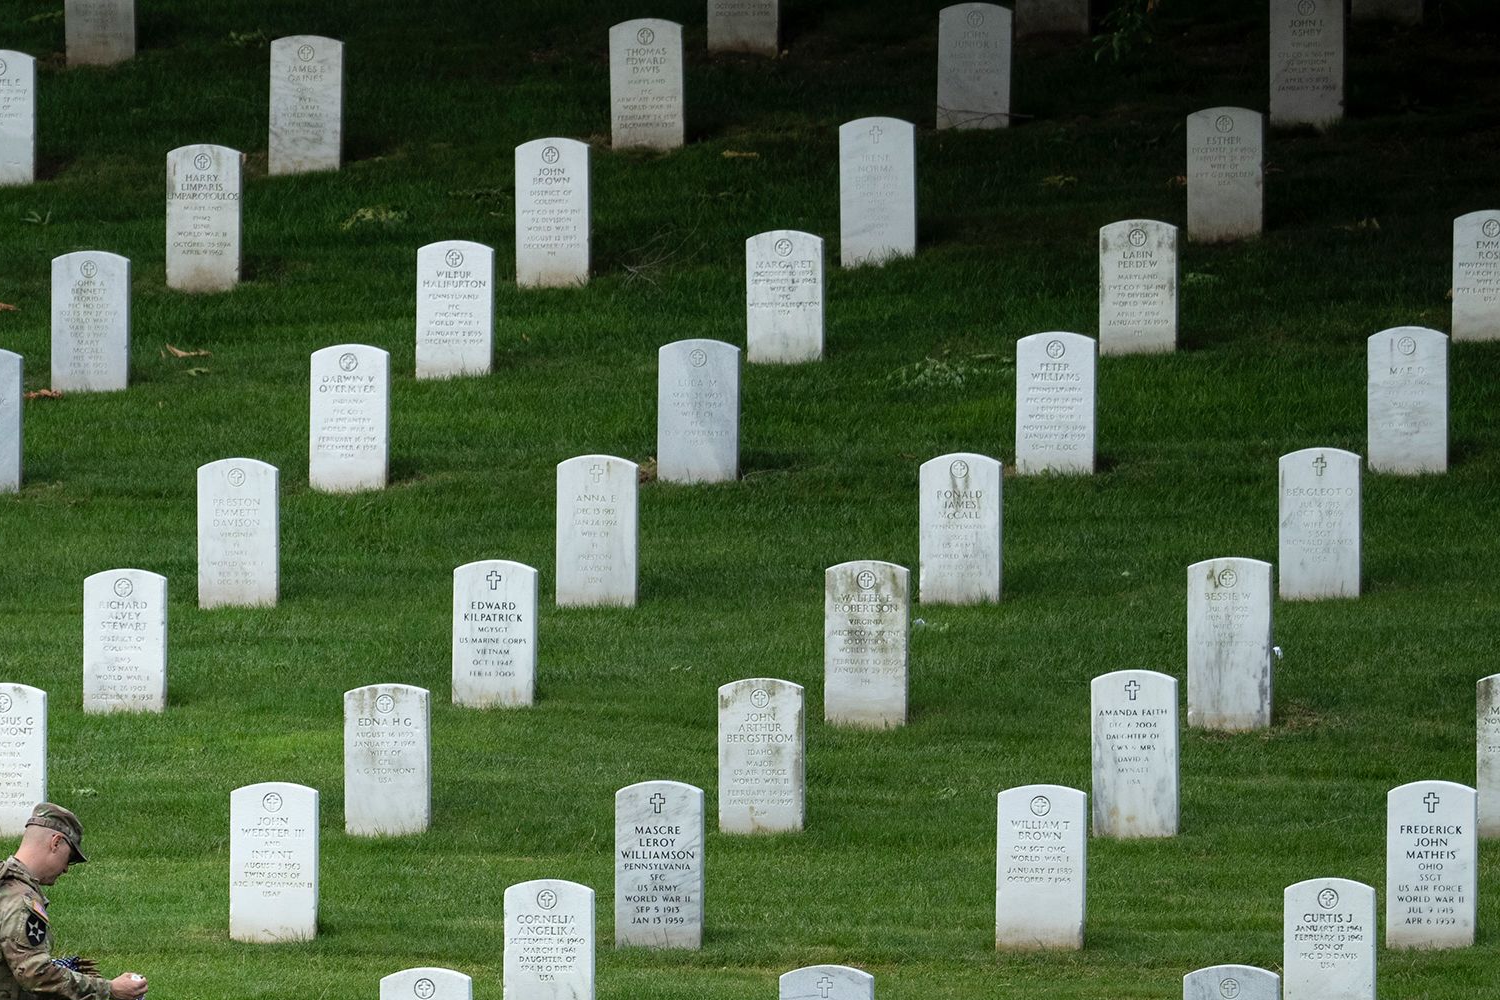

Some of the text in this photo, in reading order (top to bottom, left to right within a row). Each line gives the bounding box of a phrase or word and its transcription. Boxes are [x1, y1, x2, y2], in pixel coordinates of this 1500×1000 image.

[626, 48, 667, 56] THOMAS
[625, 57, 666, 65] EDWARD
[539, 168, 565, 176] JOHN
[185, 174, 219, 182] HARRY
[532, 176, 570, 184] BROWN
[1040, 362, 1069, 371] PETER
[1031, 372, 1080, 381] WILLIAMS
[212, 498, 261, 506] PRESTON
[215, 508, 257, 516] EMMETT
[213, 518, 260, 527] DAVISON
[471, 601, 516, 610] EDWARD
[464, 613, 522, 622] KILPATRICK
[745, 712, 776, 722] JOHN
[738, 723, 782, 732] ARTHUR
[726, 733, 793, 743] BERGSTROM
[1011, 820, 1070, 830] WILLIAM T
[1400, 825, 1462, 834] FREDERICK
[635, 826, 680, 835] MASCRE
[1018, 831, 1062, 840] BROWN
[639, 838, 675, 847] LEROY
[1416, 838, 1448, 847] JOHN
[621, 850, 695, 859] WILLIAMSON
[1406, 850, 1456, 859] MATHEIS
[650, 873, 666, 882] SFC
[637, 884, 678, 892] US ARMY
[516, 914, 575, 924] CORNELIA
[1303, 913, 1353, 923] CURTIS J
[518, 926, 575, 936] ANGELIKA
